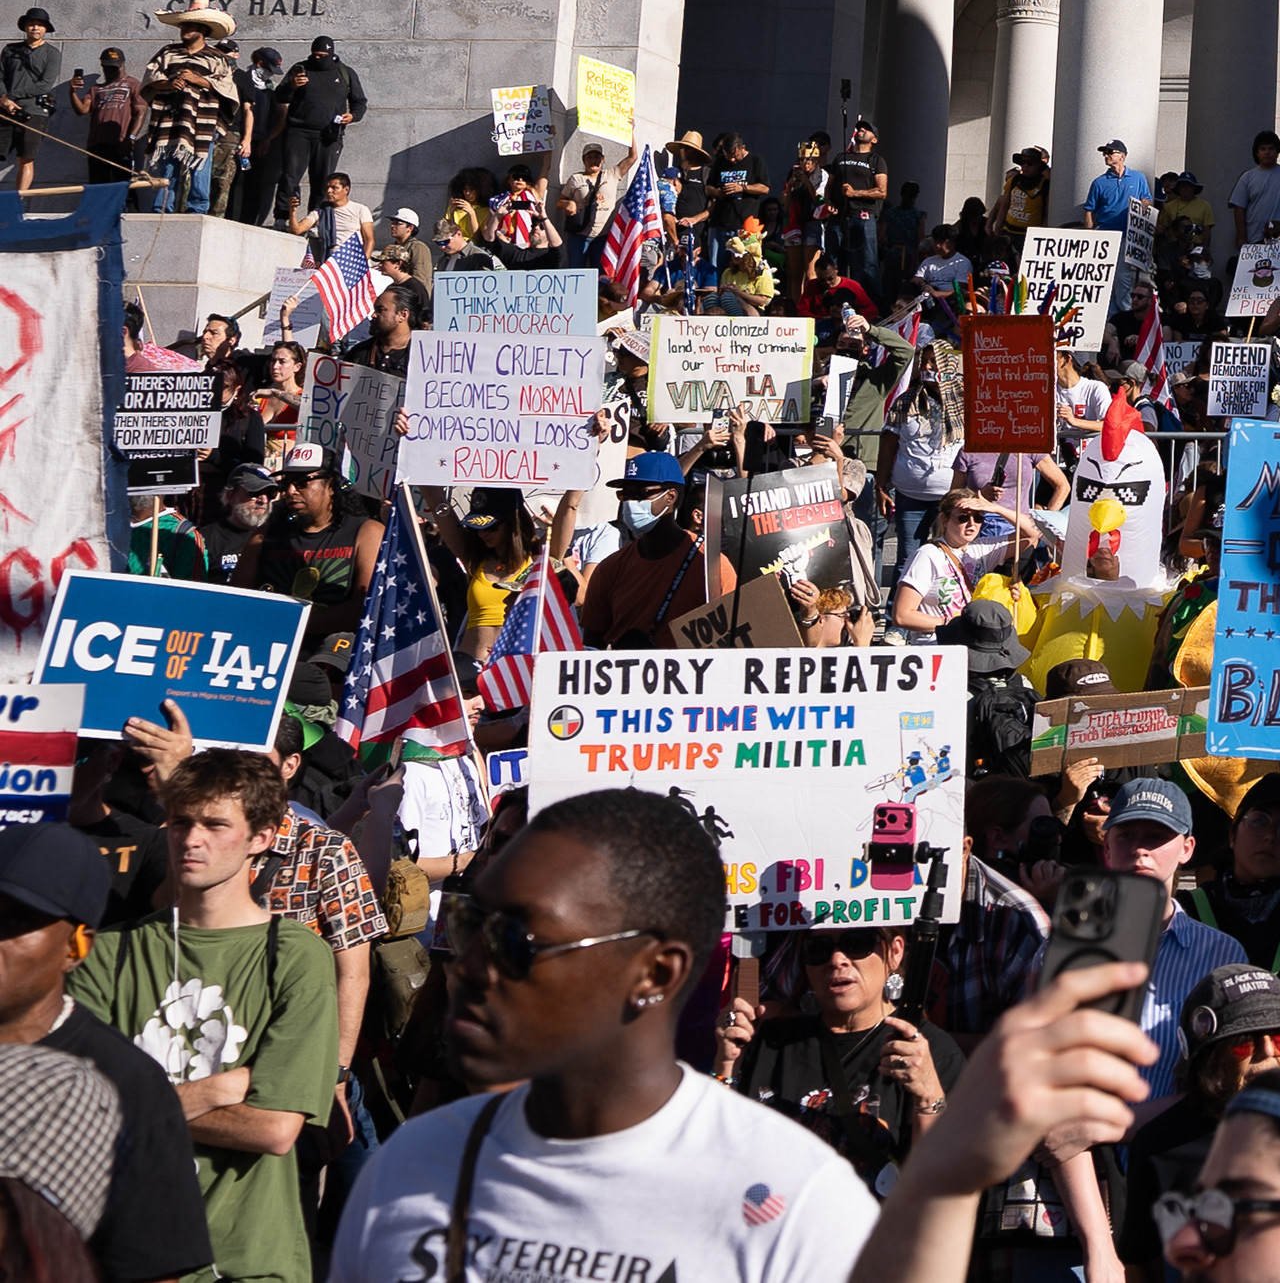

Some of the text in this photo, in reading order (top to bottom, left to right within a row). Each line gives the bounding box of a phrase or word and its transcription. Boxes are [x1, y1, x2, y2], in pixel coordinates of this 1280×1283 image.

[498, 86, 538, 101] HATE
[585, 85, 604, 99] the
[586, 70, 629, 96] Release
[491, 122, 556, 143] America
[500, 138, 555, 153] GREAT
[1033, 238, 1110, 260] TRUMP IS
[1025, 260, 1115, 282] THE WORST
[525, 274, 586, 295] DON'T
[450, 297, 498, 314] THINK
[467, 314, 574, 335] DEMOCRACY
[675, 319, 769, 341] They colonized
[419, 340, 477, 374] WHEN
[496, 344, 593, 379] CRUELTY
[715, 357, 761, 373] Families
[974, 351, 1025, 365] Researchers
[1214, 346, 1267, 366] DEFEND
[1212, 365, 1266, 378] DEMOCRACY:
[130, 375, 215, 391] THERE'S MONEY
[997, 385, 1034, 400] between
[155, 391, 214, 409] PARADE?
[424, 379, 596, 414] BECOMES NORMAL
[974, 400, 1007, 414] Donald
[1223, 391, 1260, 404] GENERAL
[143, 429, 208, 445] MEDICAID!
[404, 413, 520, 443] COMPASSION
[534, 421, 590, 450] LOOKS
[453, 446, 549, 476] RADICAL
[741, 479, 836, 516] STAND WITH
[751, 513, 782, 536] THE
[50, 619, 164, 676] ICE
[165, 629, 204, 656] OUT
[164, 654, 192, 680] OF
[558, 654, 943, 695] HISTORY REPEATS!
[596, 705, 855, 734] THIS TIME WITH
[580, 739, 867, 772] TRUMPS MILITIA
[760, 897, 918, 926] FOR PROFIT
